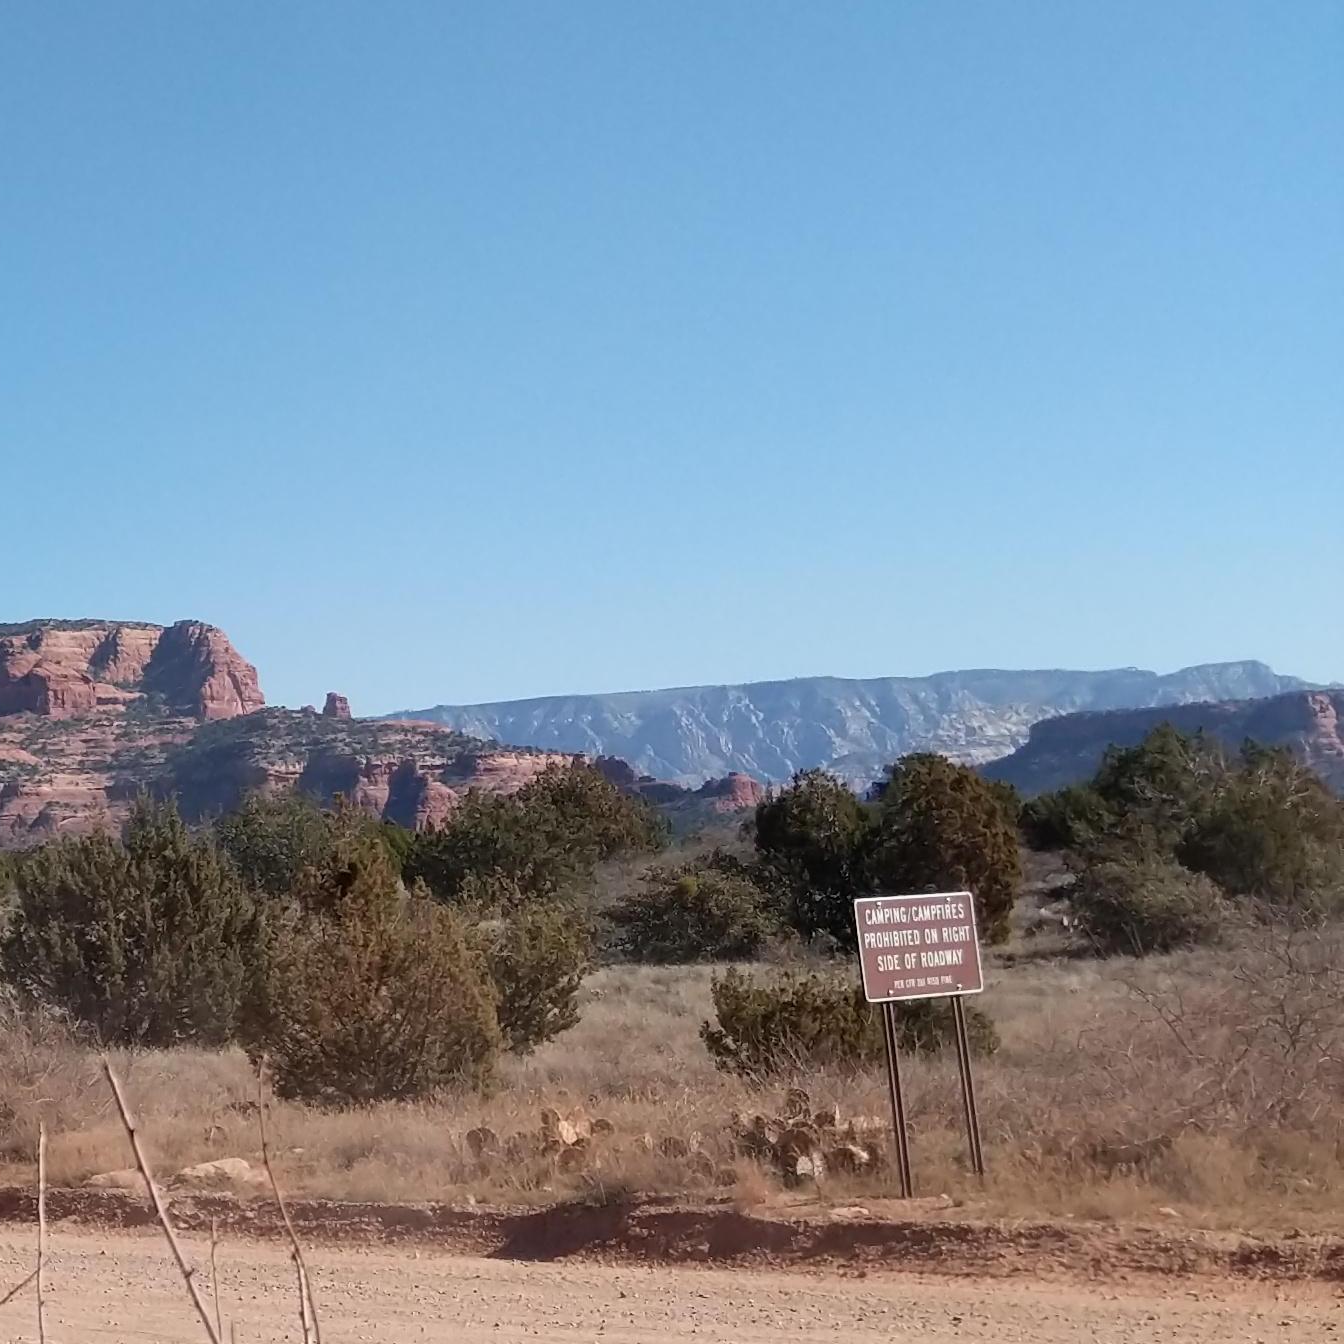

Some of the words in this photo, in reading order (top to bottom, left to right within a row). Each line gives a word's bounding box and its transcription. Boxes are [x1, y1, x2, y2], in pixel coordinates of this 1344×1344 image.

[865, 903, 965, 925] CAMPING/CAMPFIRES
[864, 929, 920, 949] PROHIBITED
[924, 927, 939, 944] ON
[942, 925, 970, 943] RIGHT
[877, 954, 901, 972] SIDE
[904, 952, 917, 970] OF
[921, 949, 963, 968] ROADWAY
